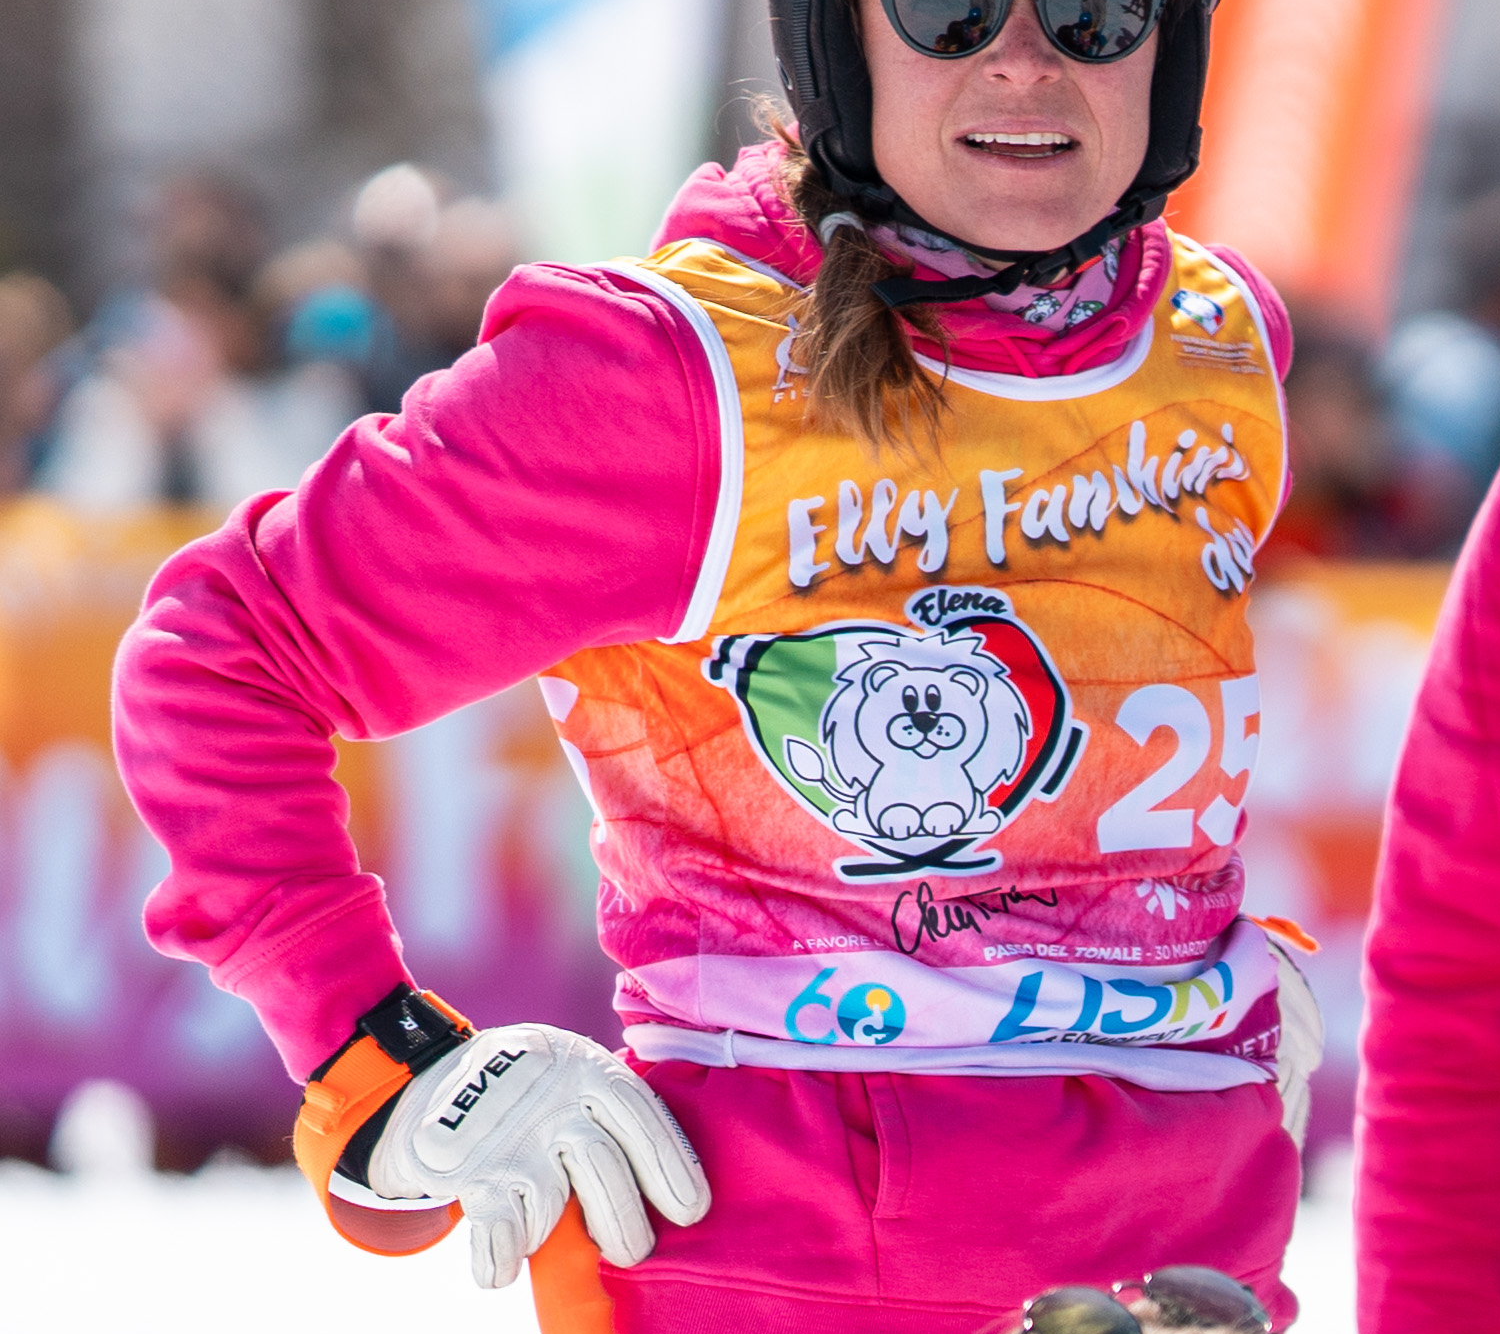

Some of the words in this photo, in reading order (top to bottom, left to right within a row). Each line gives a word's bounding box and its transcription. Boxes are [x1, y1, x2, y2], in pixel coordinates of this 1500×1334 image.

[787, 477, 959, 588] Elly
[910, 588, 1008, 628] Elena
[792, 938, 806, 950] A
[807, 934, 870, 950] FAVORE
[983, 943, 1034, 962] PASSO
[1036, 942, 1069, 958] DEL
[1075, 945, 1141, 962] TONALE
[1154, 944, 1172, 961] 30
[437, 1049, 528, 1131] LEVEL
